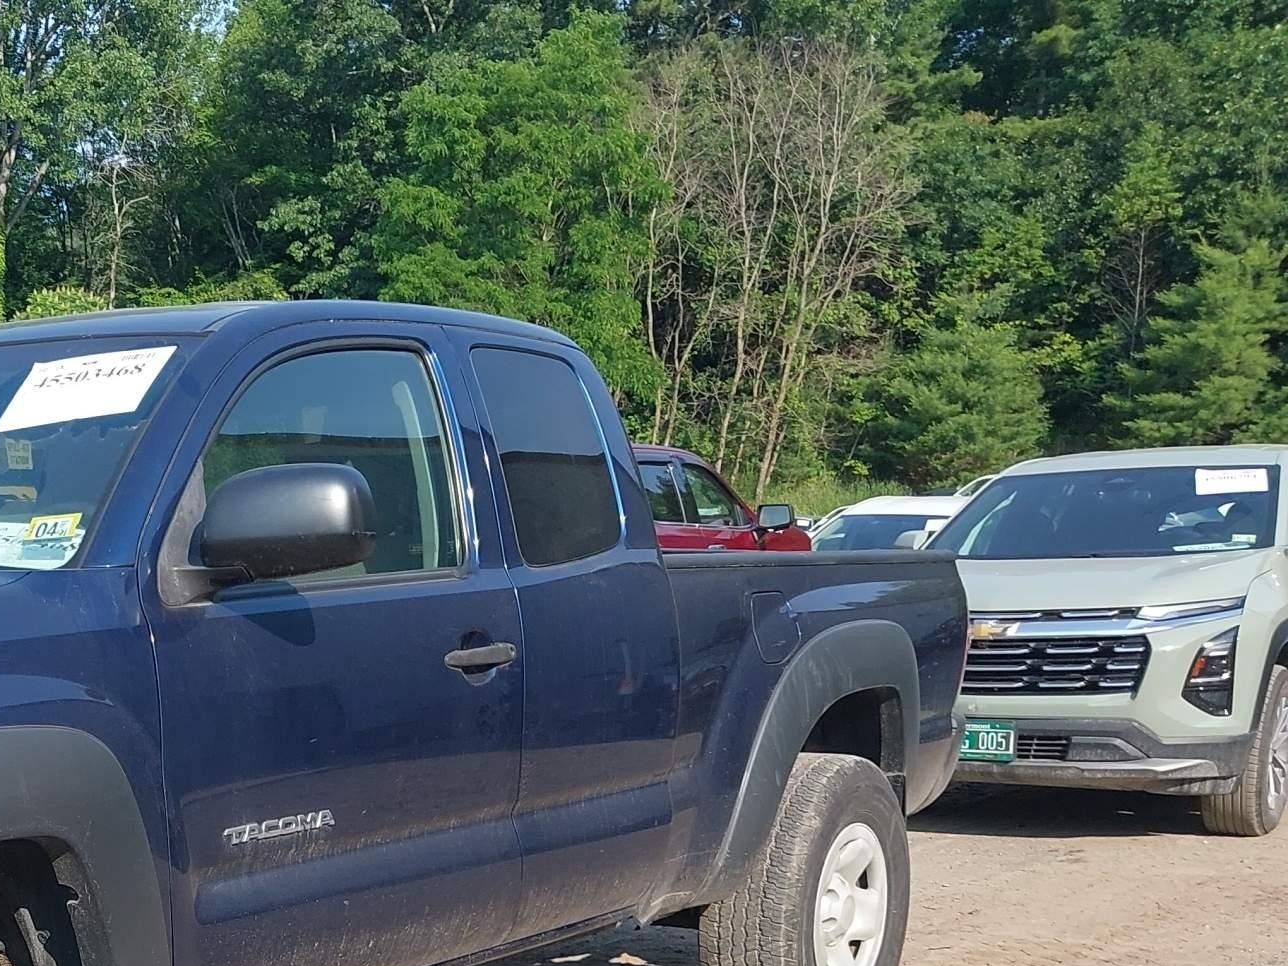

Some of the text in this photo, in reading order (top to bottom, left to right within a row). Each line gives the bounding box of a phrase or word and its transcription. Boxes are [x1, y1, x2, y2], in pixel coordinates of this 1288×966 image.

[34, 521, 58, 538] 04
[978, 731, 1006, 751] 005
[223, 808, 336, 846] TACOMA
